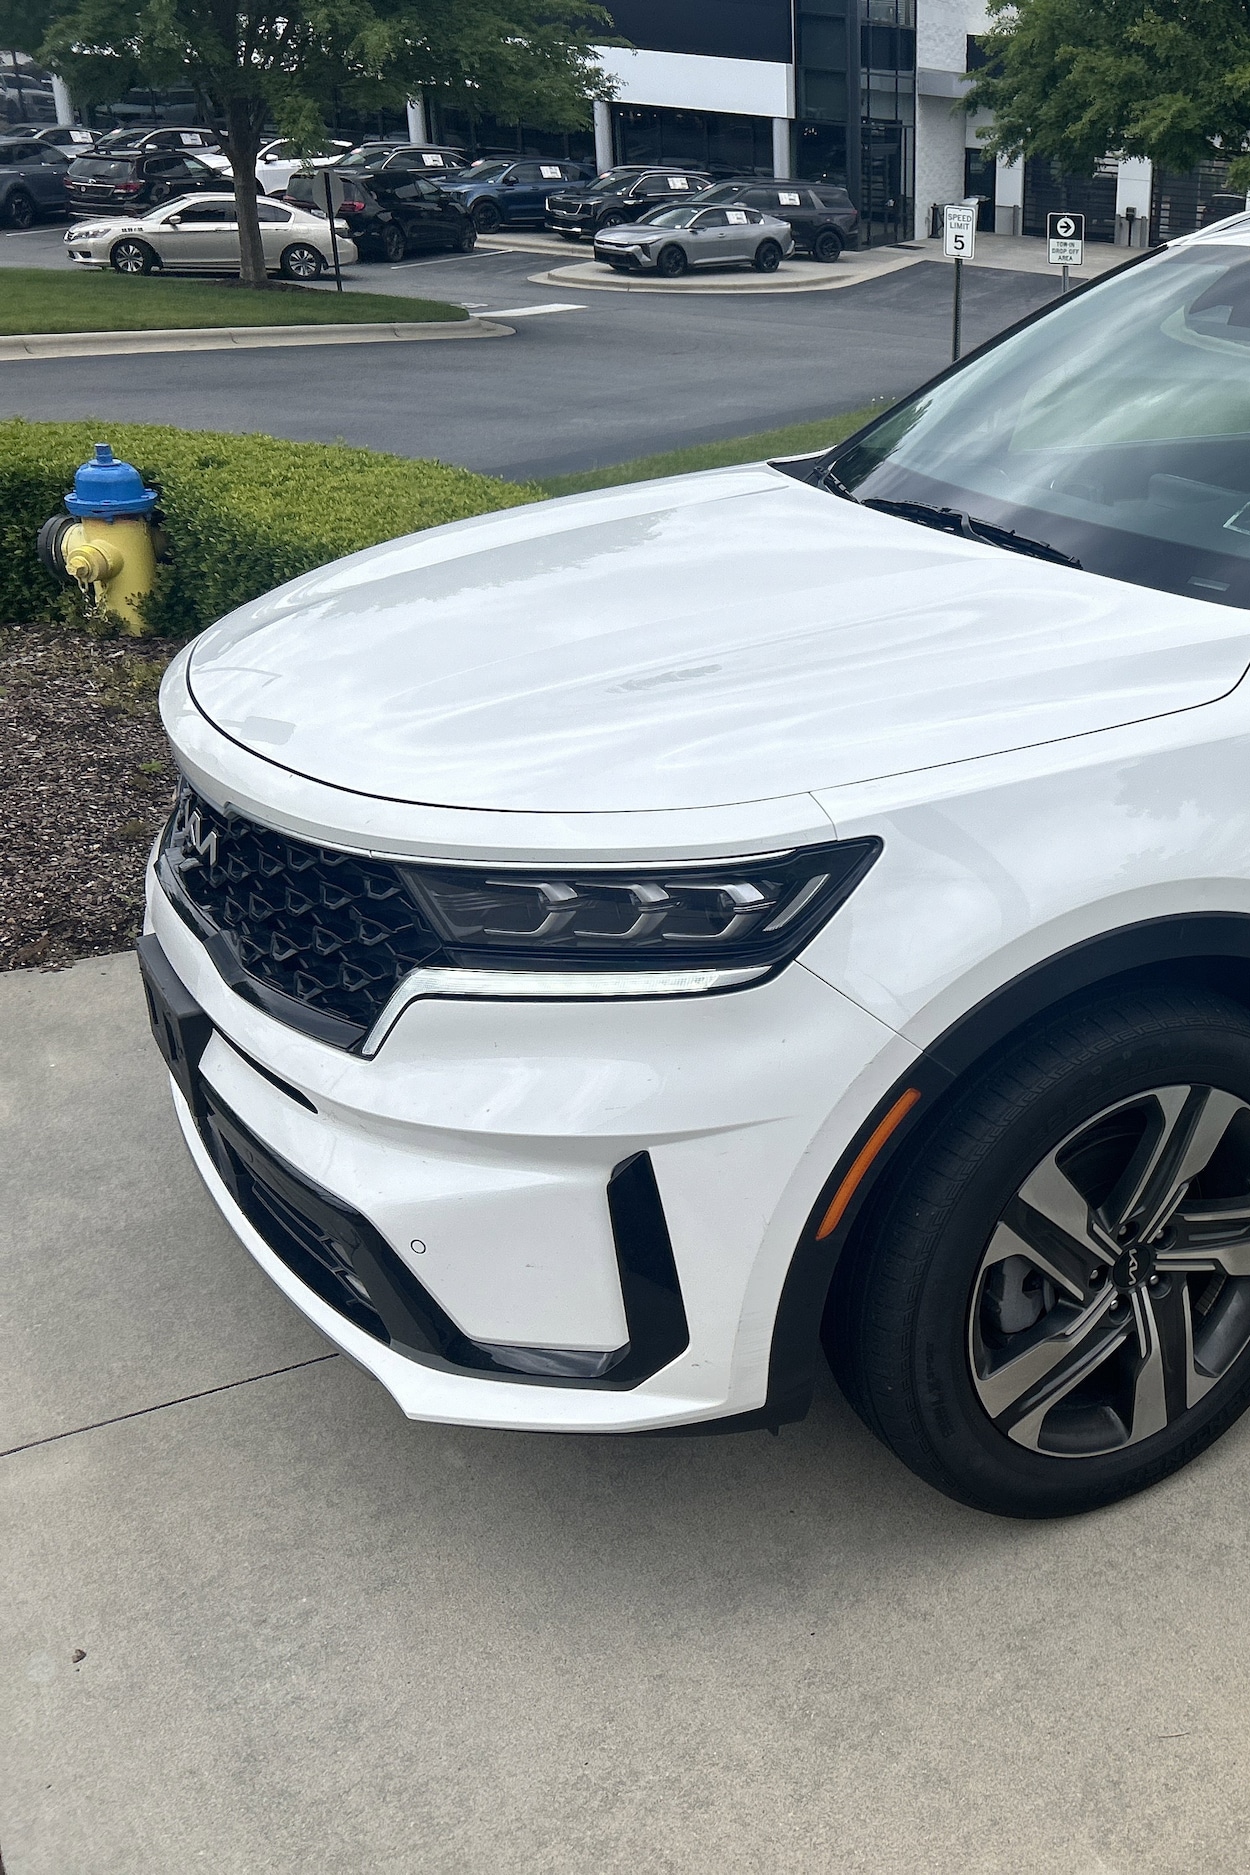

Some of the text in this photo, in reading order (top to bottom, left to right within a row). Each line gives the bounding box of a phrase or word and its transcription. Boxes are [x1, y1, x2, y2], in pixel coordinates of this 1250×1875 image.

[948, 213, 972, 222] SPEED
[950, 222, 970, 230] LIMIT
[954, 235, 965, 250] 5
[1057, 254, 1073, 262] AREA
